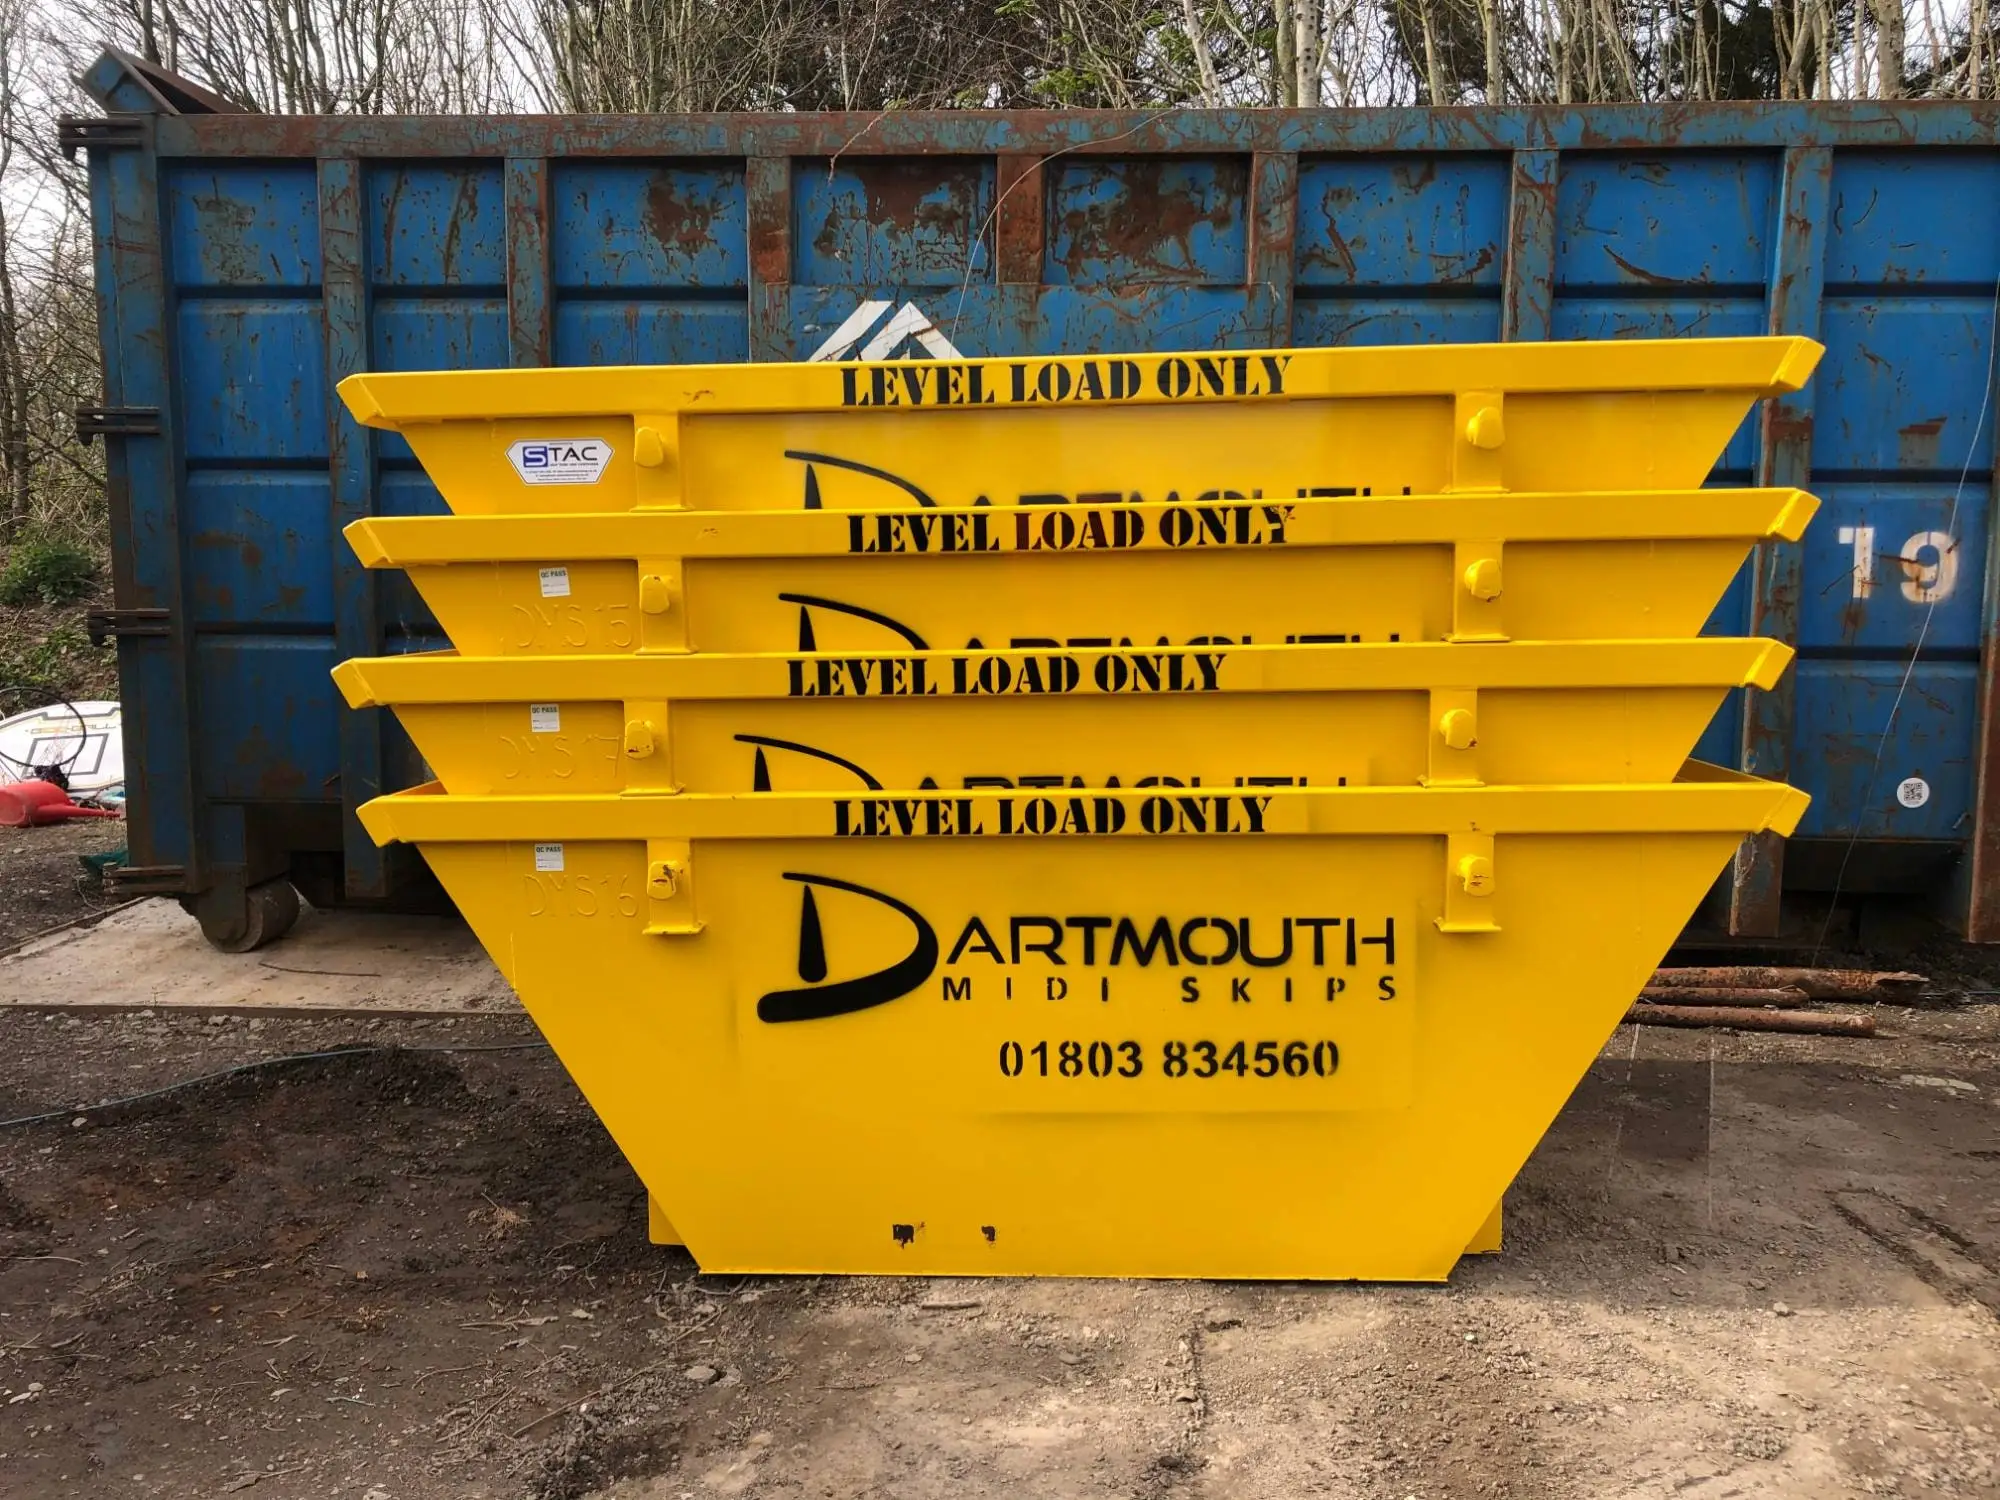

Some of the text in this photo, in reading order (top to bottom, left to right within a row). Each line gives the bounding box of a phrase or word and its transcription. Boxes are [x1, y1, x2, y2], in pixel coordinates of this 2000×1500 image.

[841, 356, 1293, 406] LEVEL LOAD ONLY
[523, 446, 597, 467] STAC
[848, 505, 1296, 553] LEVEL LOAD ONLY
[1838, 527, 1958, 603] 19
[787, 653, 1227, 697] LEVEL LOAD ONLY
[834, 795, 1273, 836] LEVEL LOAD ONLY
[757, 872, 1396, 1023] DARTMOUTH
[942, 975, 1396, 1003] MIDI SKIPS
[999, 1040, 1340, 1078] 01803 834560
